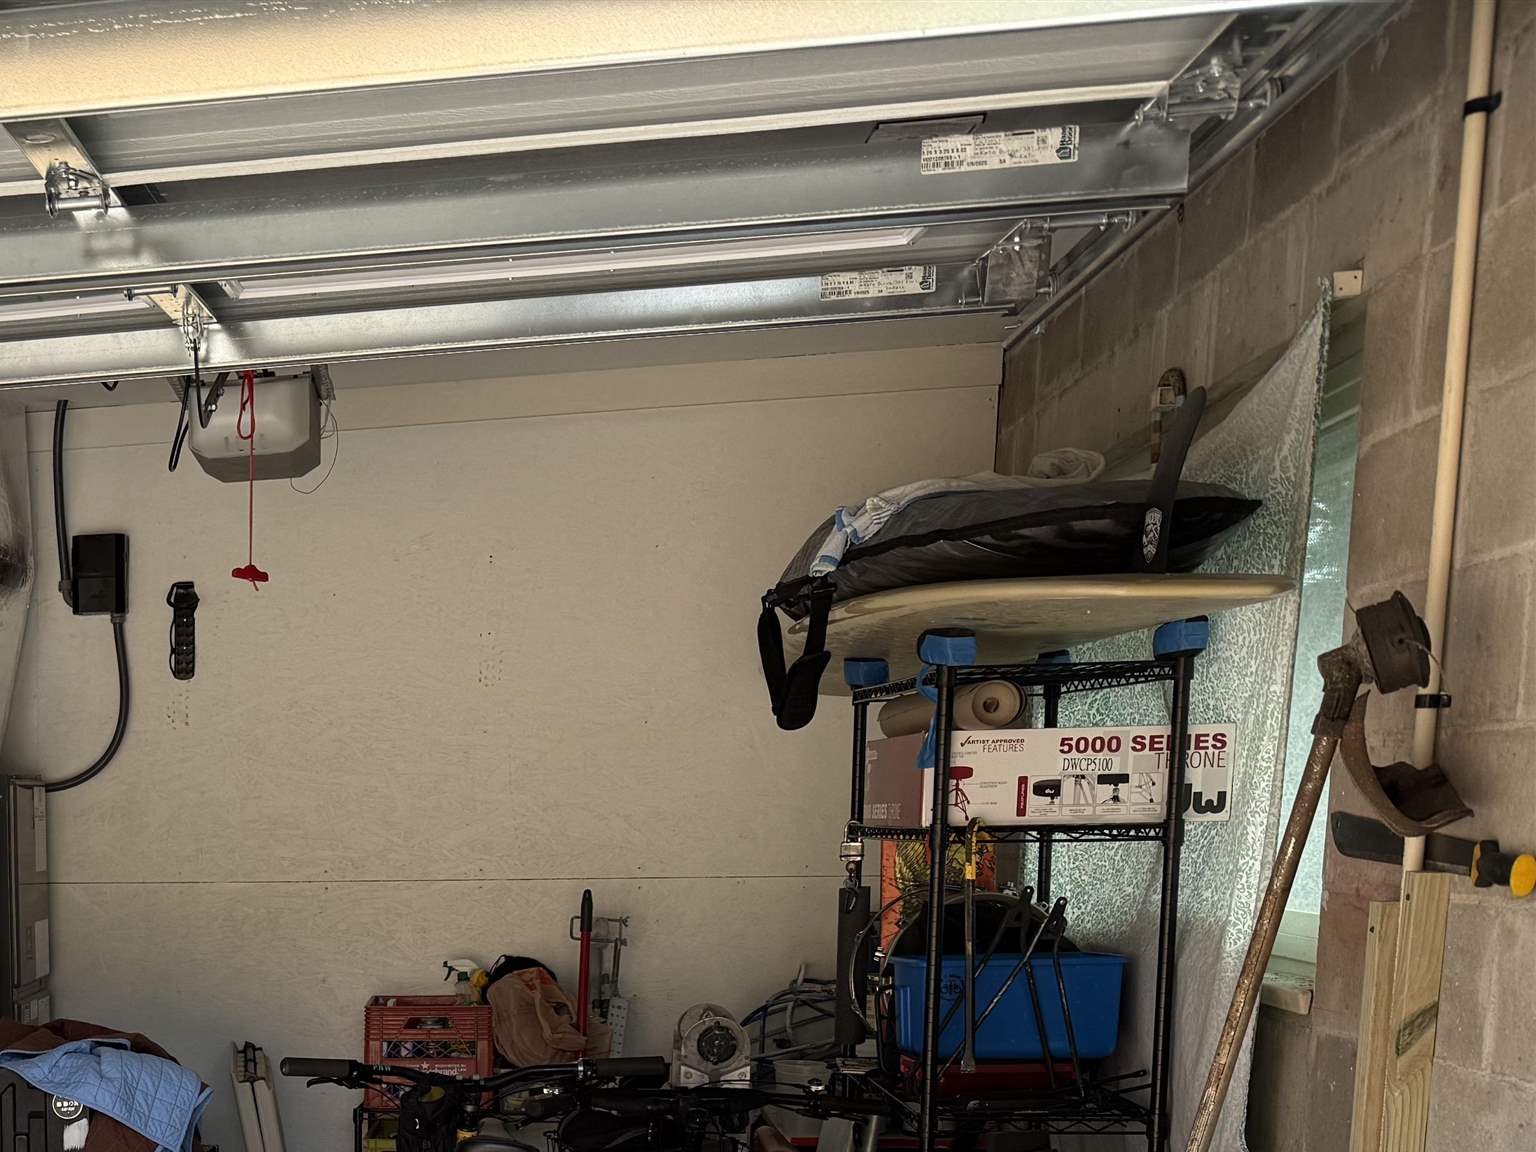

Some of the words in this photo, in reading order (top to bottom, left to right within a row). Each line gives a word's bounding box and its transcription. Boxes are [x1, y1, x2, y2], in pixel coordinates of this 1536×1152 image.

[982, 744, 1025, 753] FEATURES
[1059, 735, 1121, 754] 5000
[1062, 757, 1113, 771] DWCP5100
